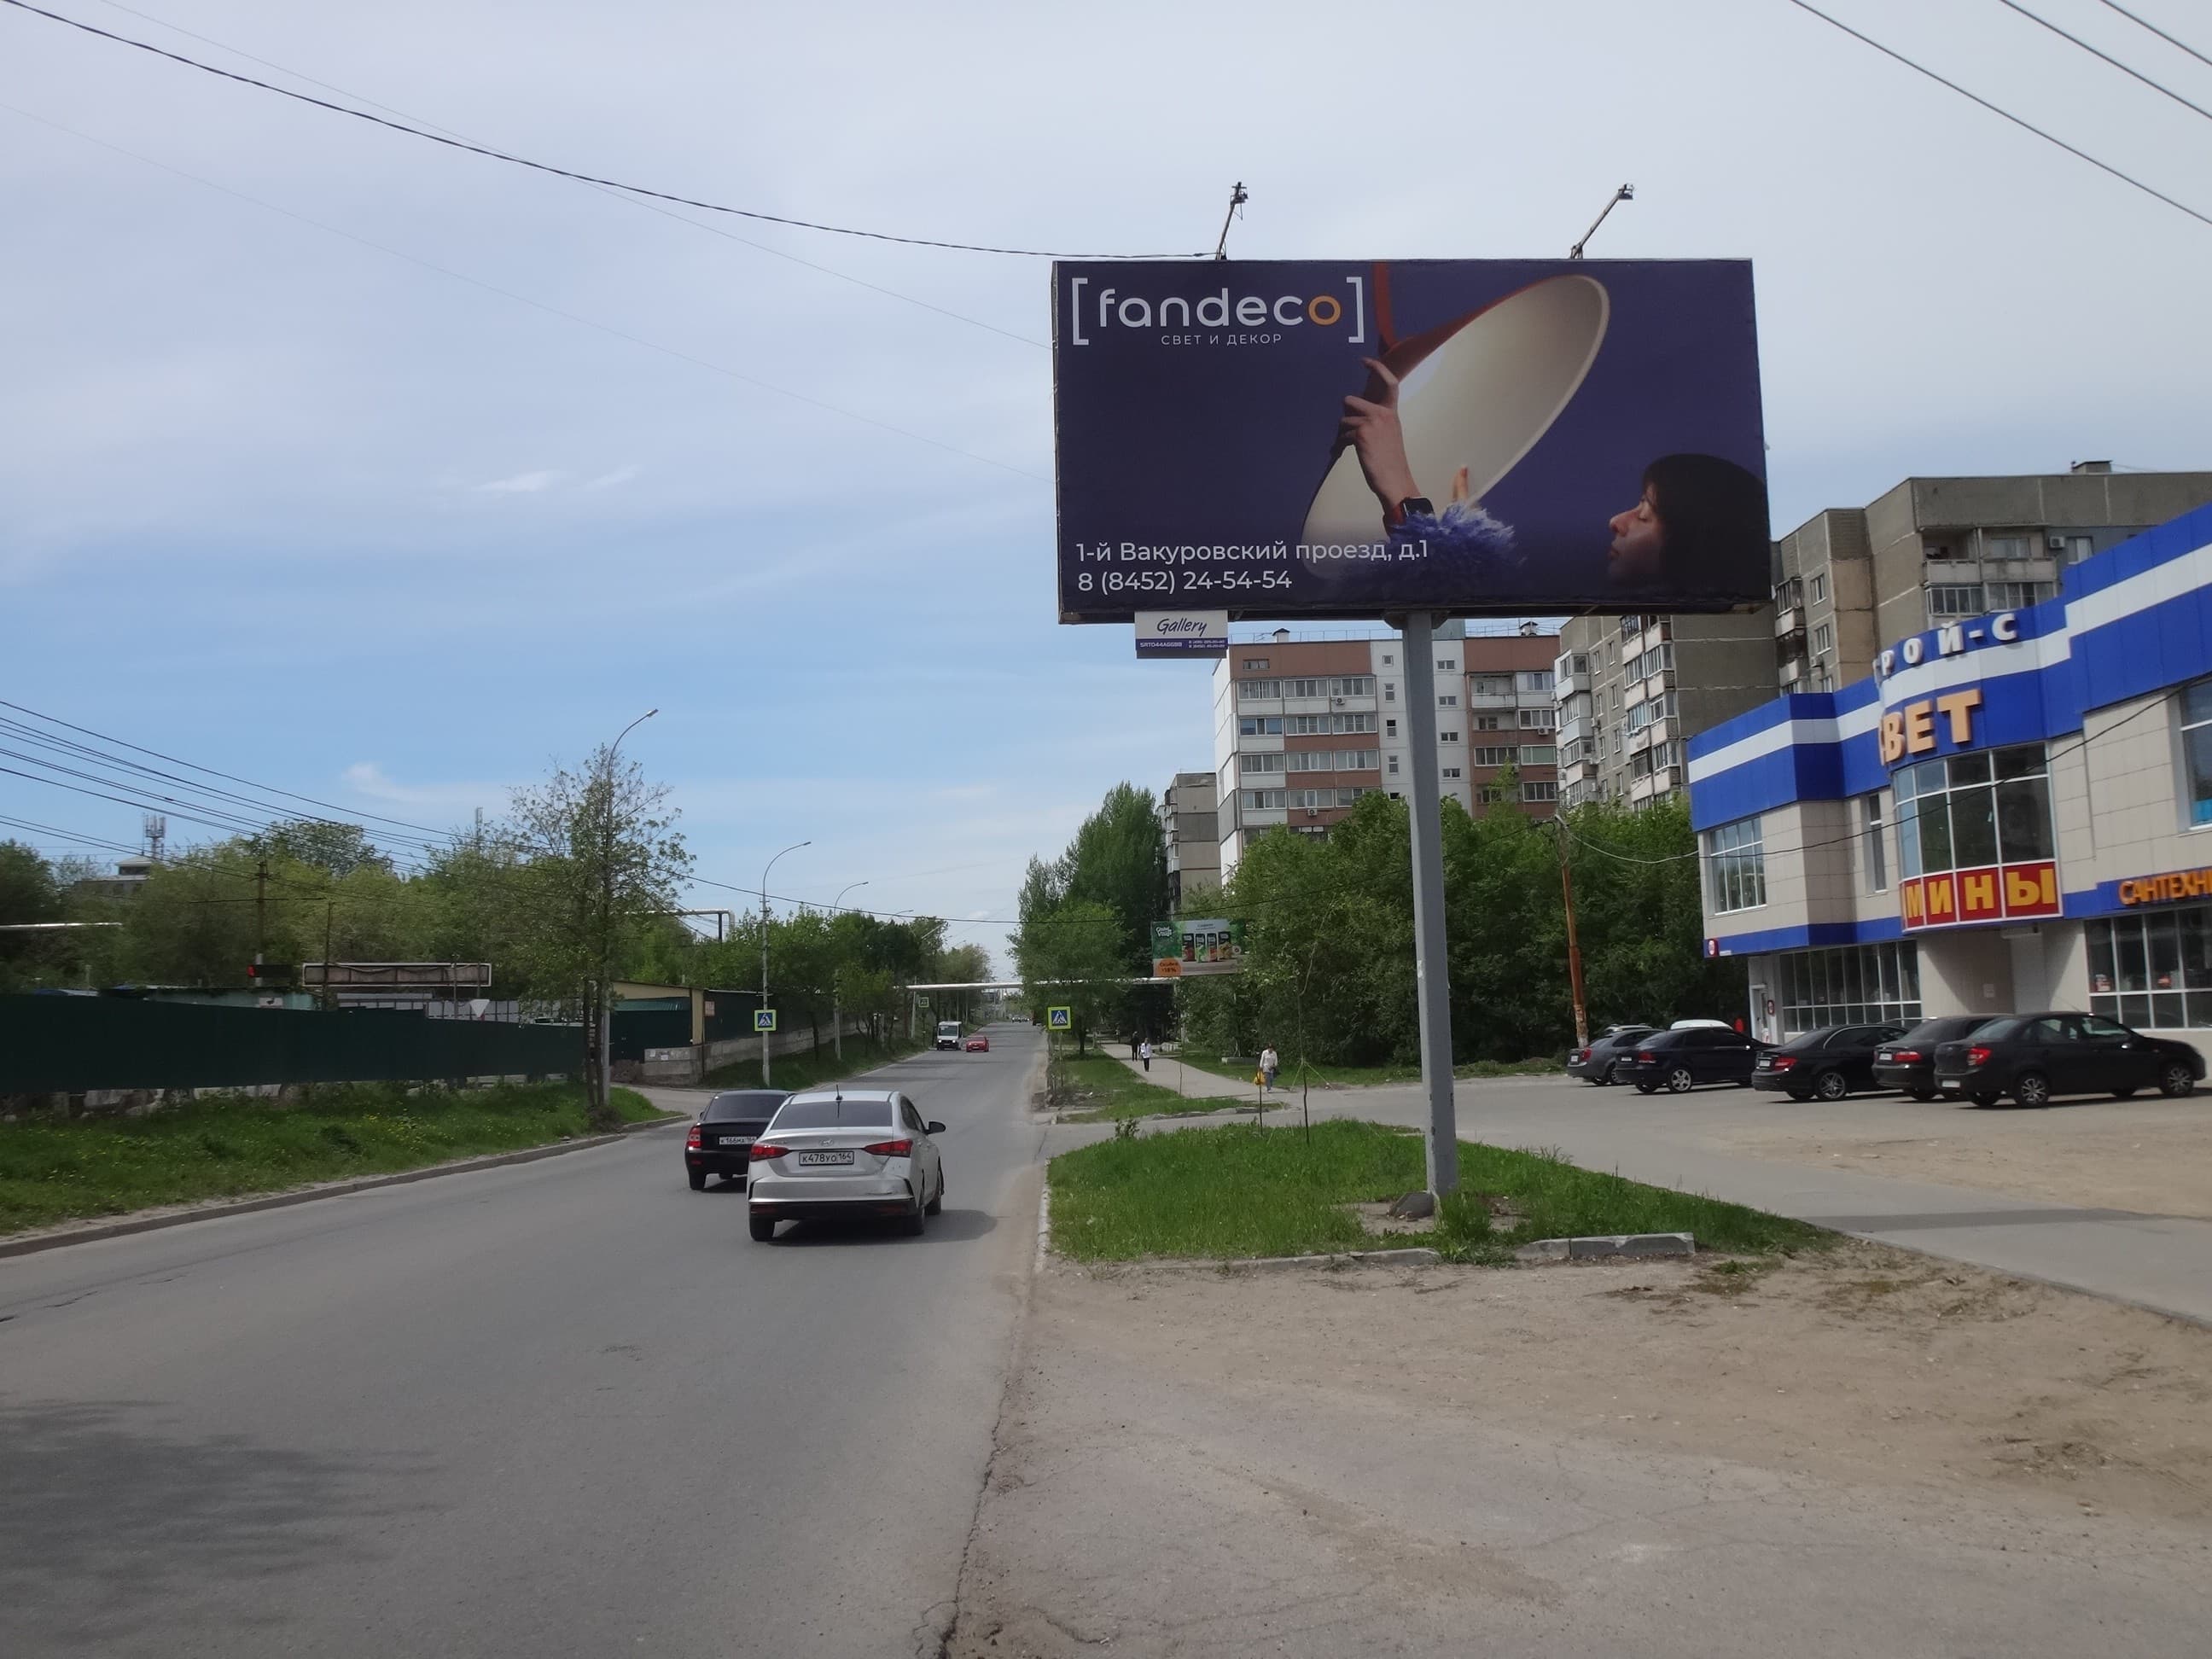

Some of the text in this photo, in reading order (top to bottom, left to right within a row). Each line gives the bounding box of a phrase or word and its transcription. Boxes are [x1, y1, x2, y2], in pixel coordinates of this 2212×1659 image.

[1161, 333, 1283, 346] СВЕТ И ДЕКОР
[1075, 539, 1429, 567] 1-й Вакуровский проезд, д.1
[1077, 569, 1293, 595] 8 (8452) 24-54-54
[1156, 617, 1208, 637] Gallery
[1879, 689, 1982, 765] ВЕТ
[1901, 868, 2057, 920] МИНЫ
